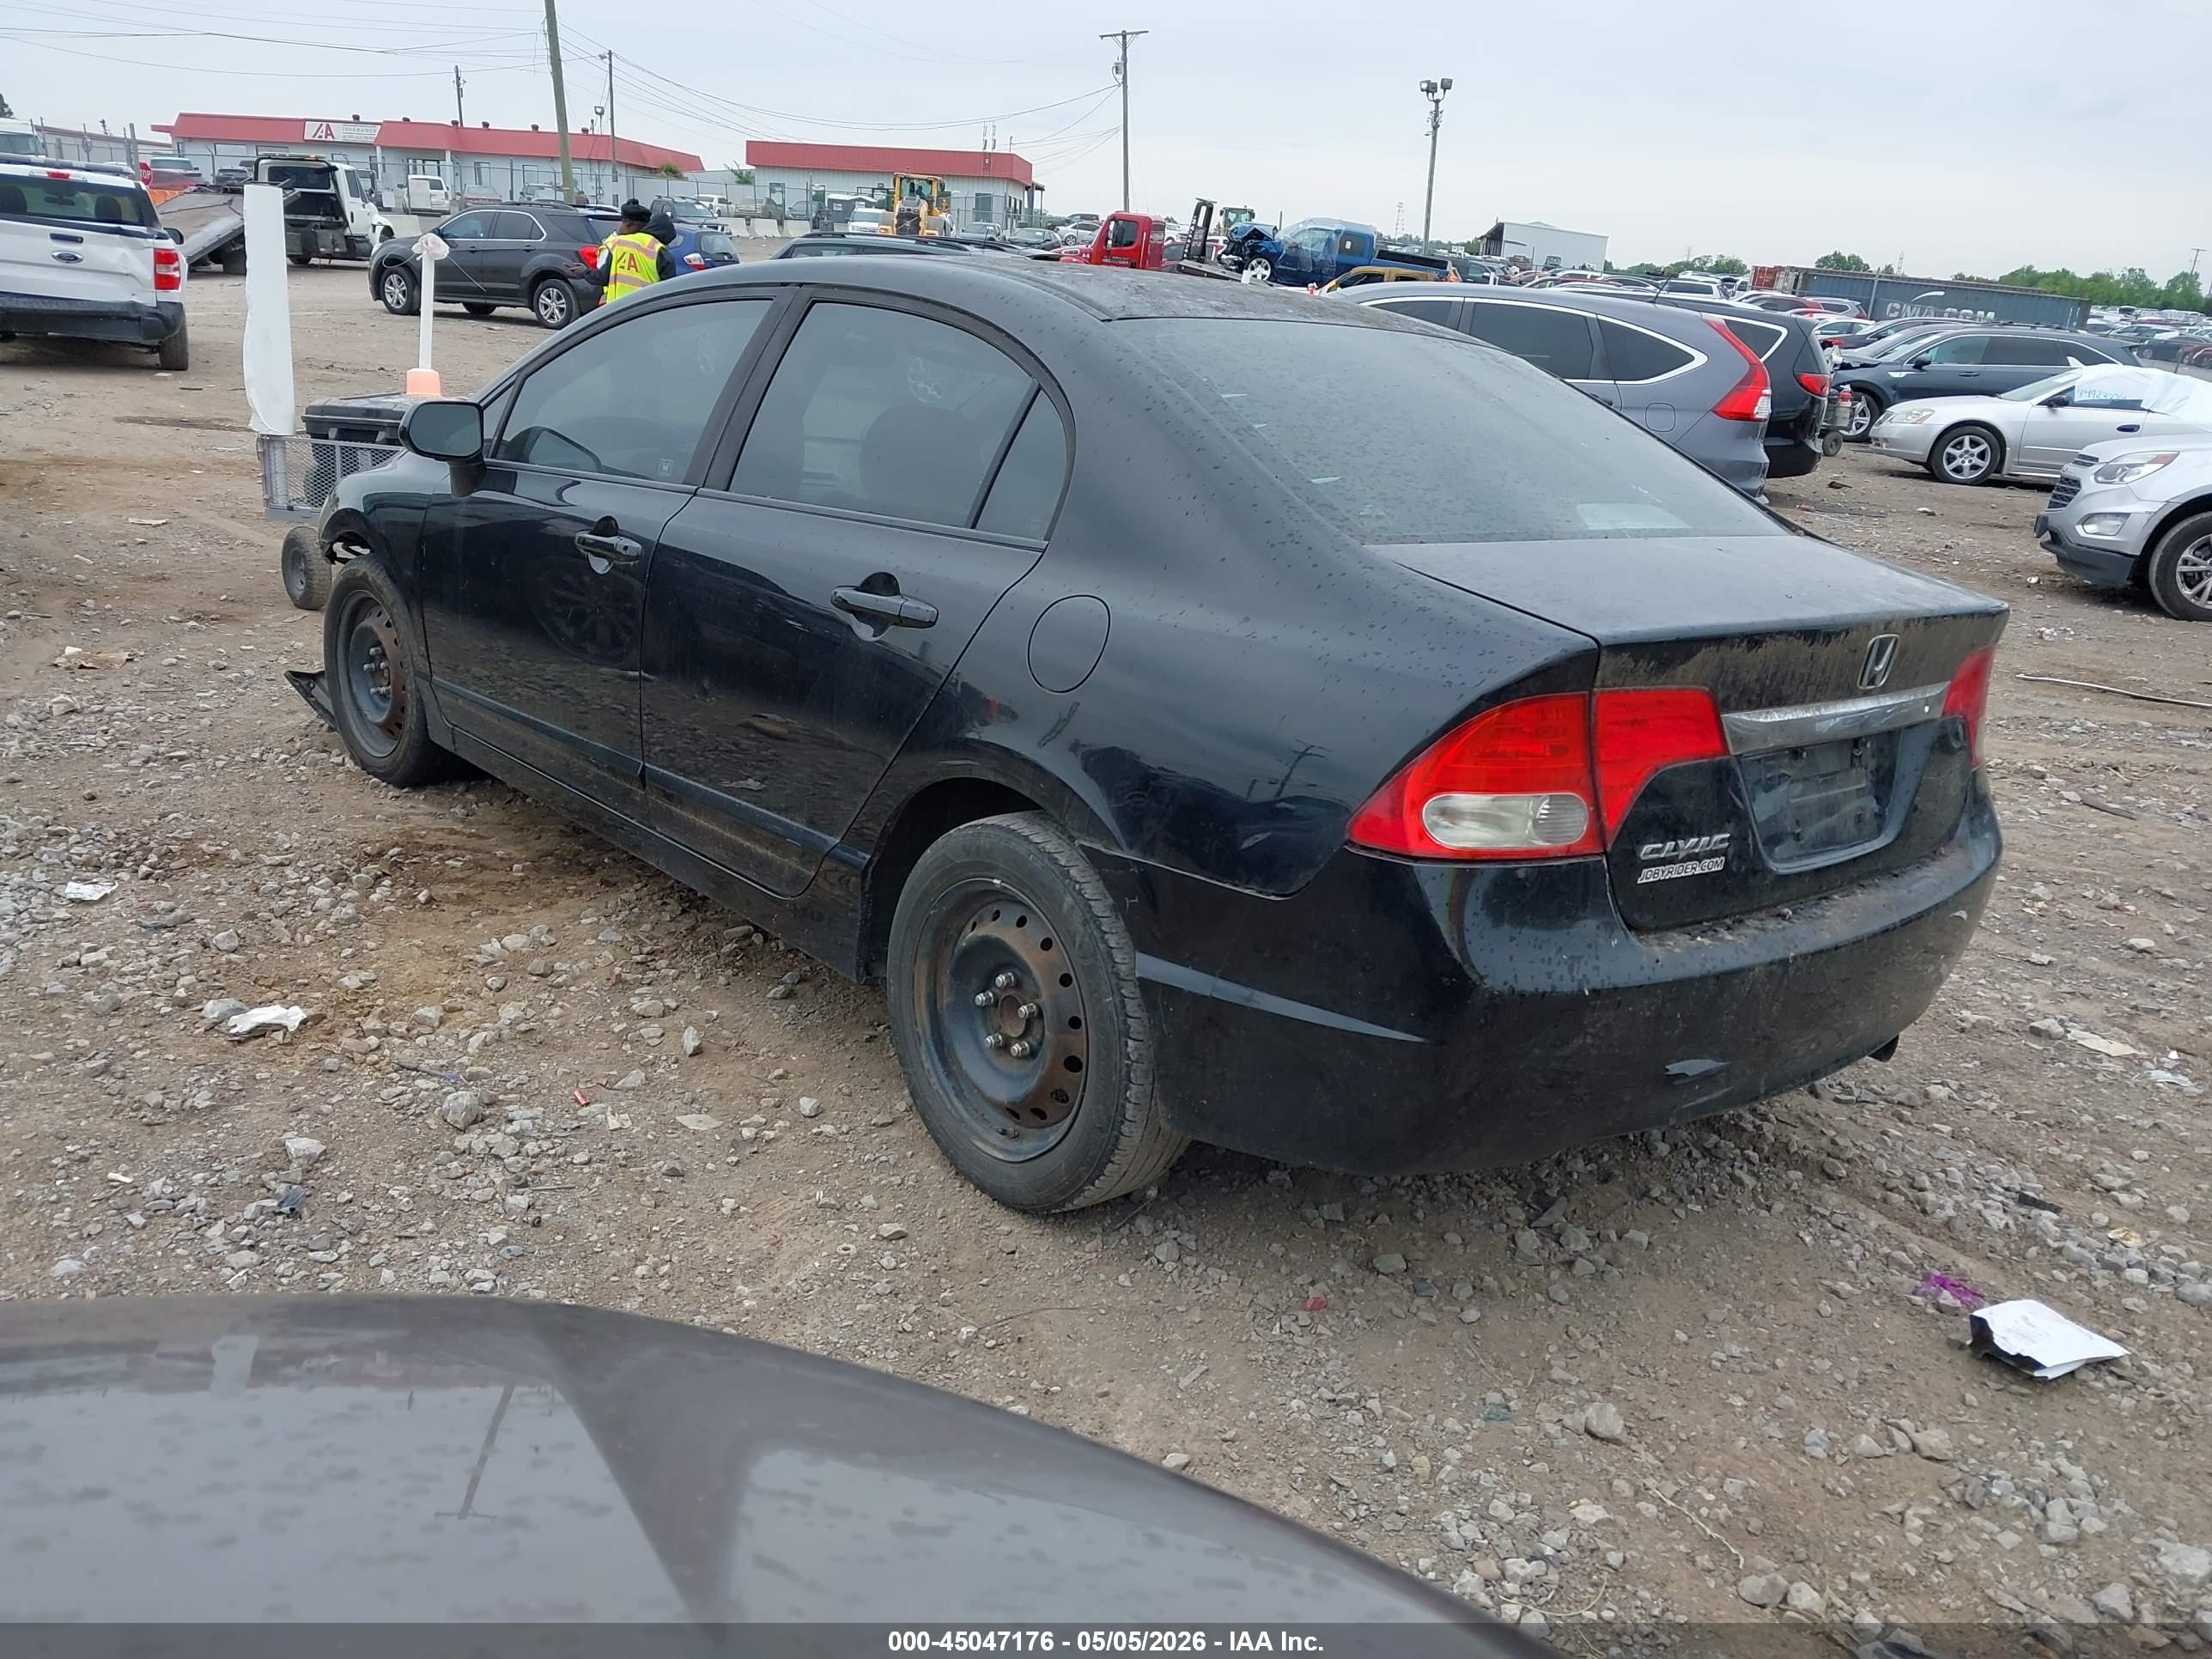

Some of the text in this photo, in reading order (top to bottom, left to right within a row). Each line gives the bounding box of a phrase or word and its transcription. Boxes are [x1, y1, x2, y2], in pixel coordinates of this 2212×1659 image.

[138, 169, 151, 179] TOP
[1886, 302, 1935, 318] CMA
[1640, 833, 1731, 860] CIVIC
